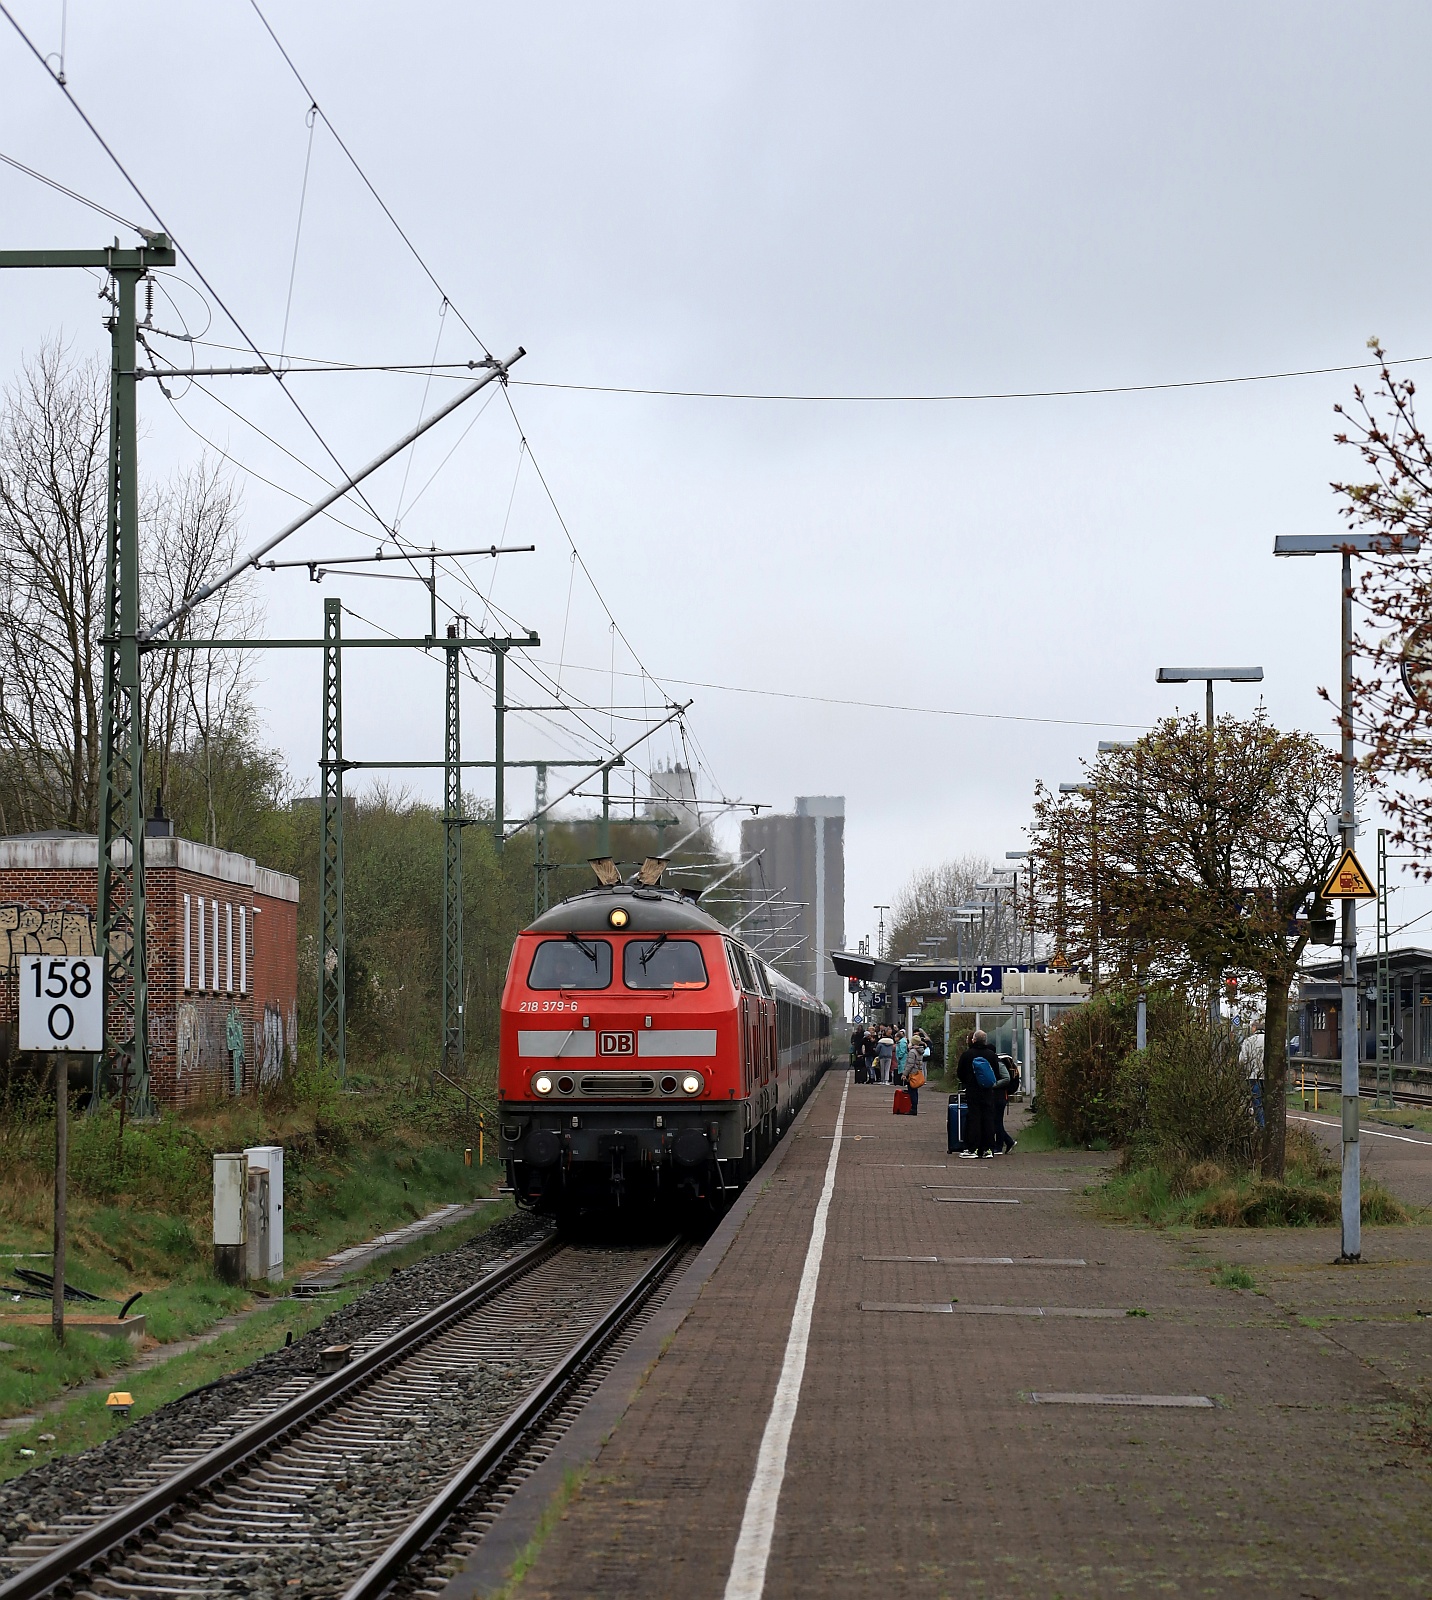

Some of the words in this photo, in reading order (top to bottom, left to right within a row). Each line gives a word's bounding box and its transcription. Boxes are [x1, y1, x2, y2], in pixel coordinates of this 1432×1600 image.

[31, 961, 91, 998] 158
[980, 967, 993, 986] 5
[940, 982, 948, 994] 5
[956, 981, 966, 993] C
[519, 1001, 539, 1012] 218
[542, 1001, 578, 1012] 379-6
[874, 993, 881, 1004] 5
[47, 1003, 74, 1041] 0
[603, 1034, 631, 1052] DB
